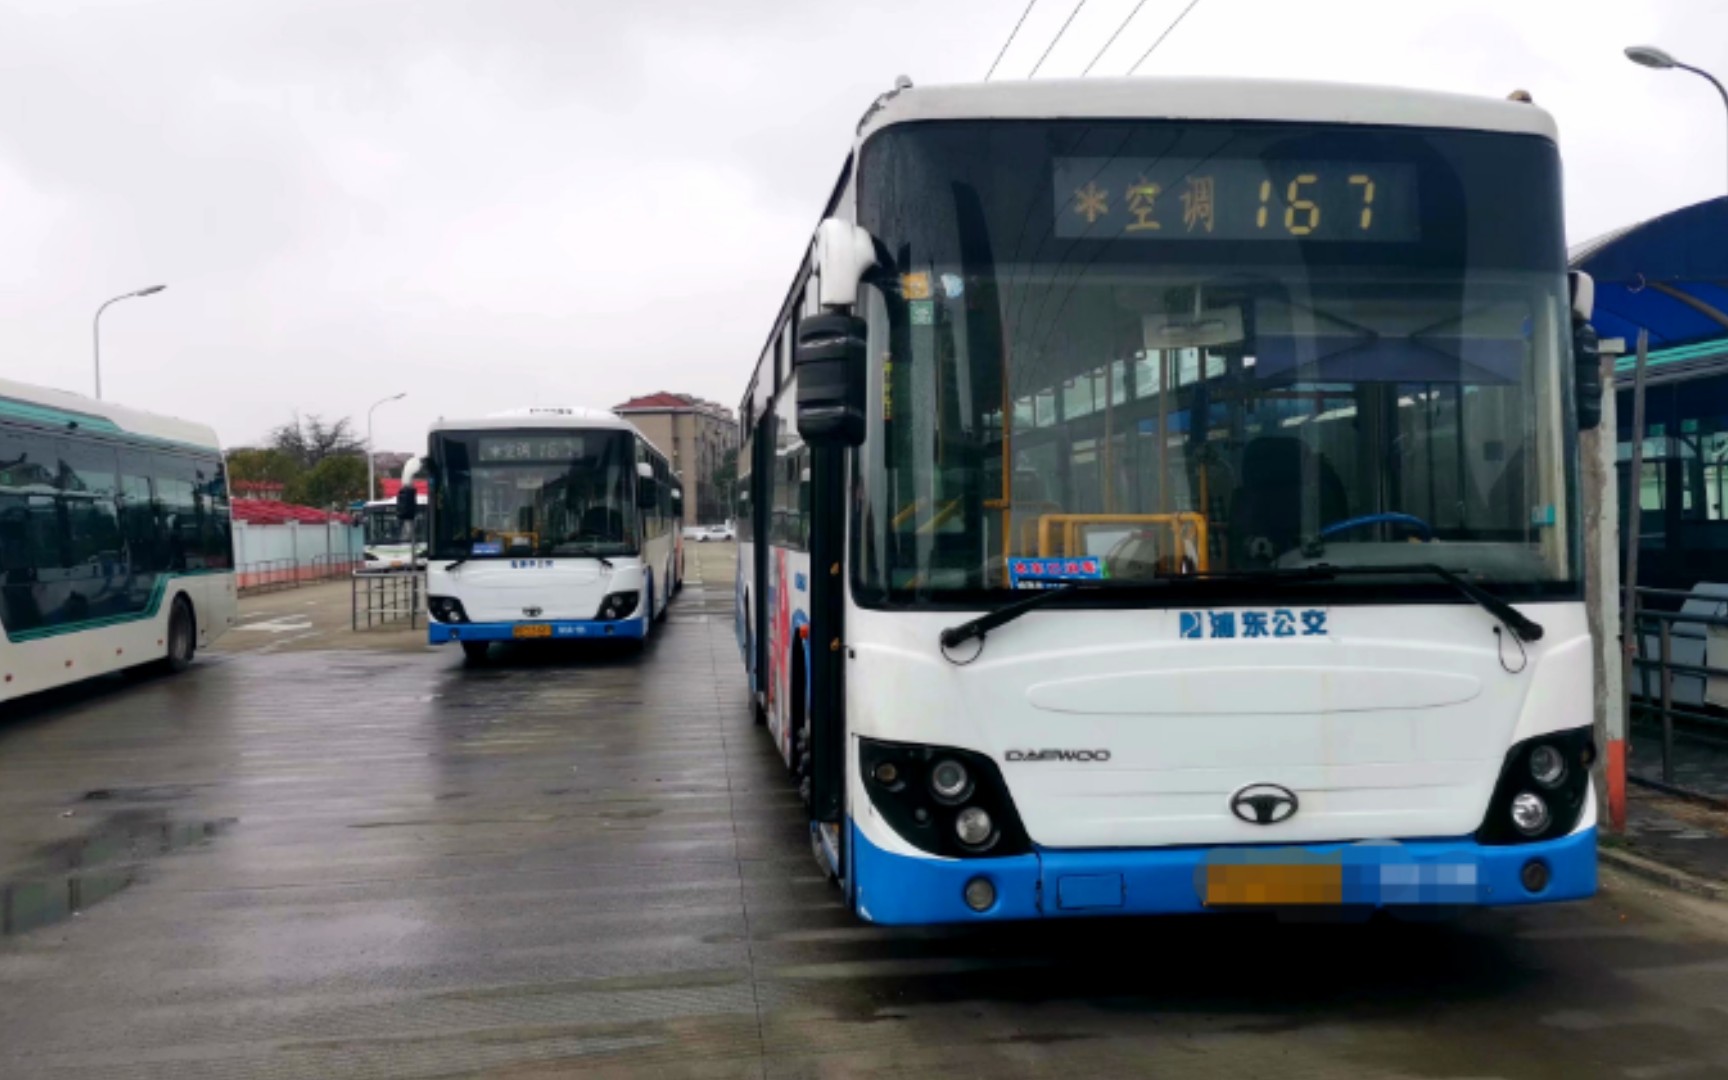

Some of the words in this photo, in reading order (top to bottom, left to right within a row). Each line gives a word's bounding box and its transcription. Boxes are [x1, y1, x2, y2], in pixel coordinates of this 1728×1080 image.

[1125, 175, 1214, 232] 空调
[1256, 174, 1375, 235] 167
[1208, 609, 1328, 639] 浦东公交
[1004, 749, 1111, 762] DAEWOO
